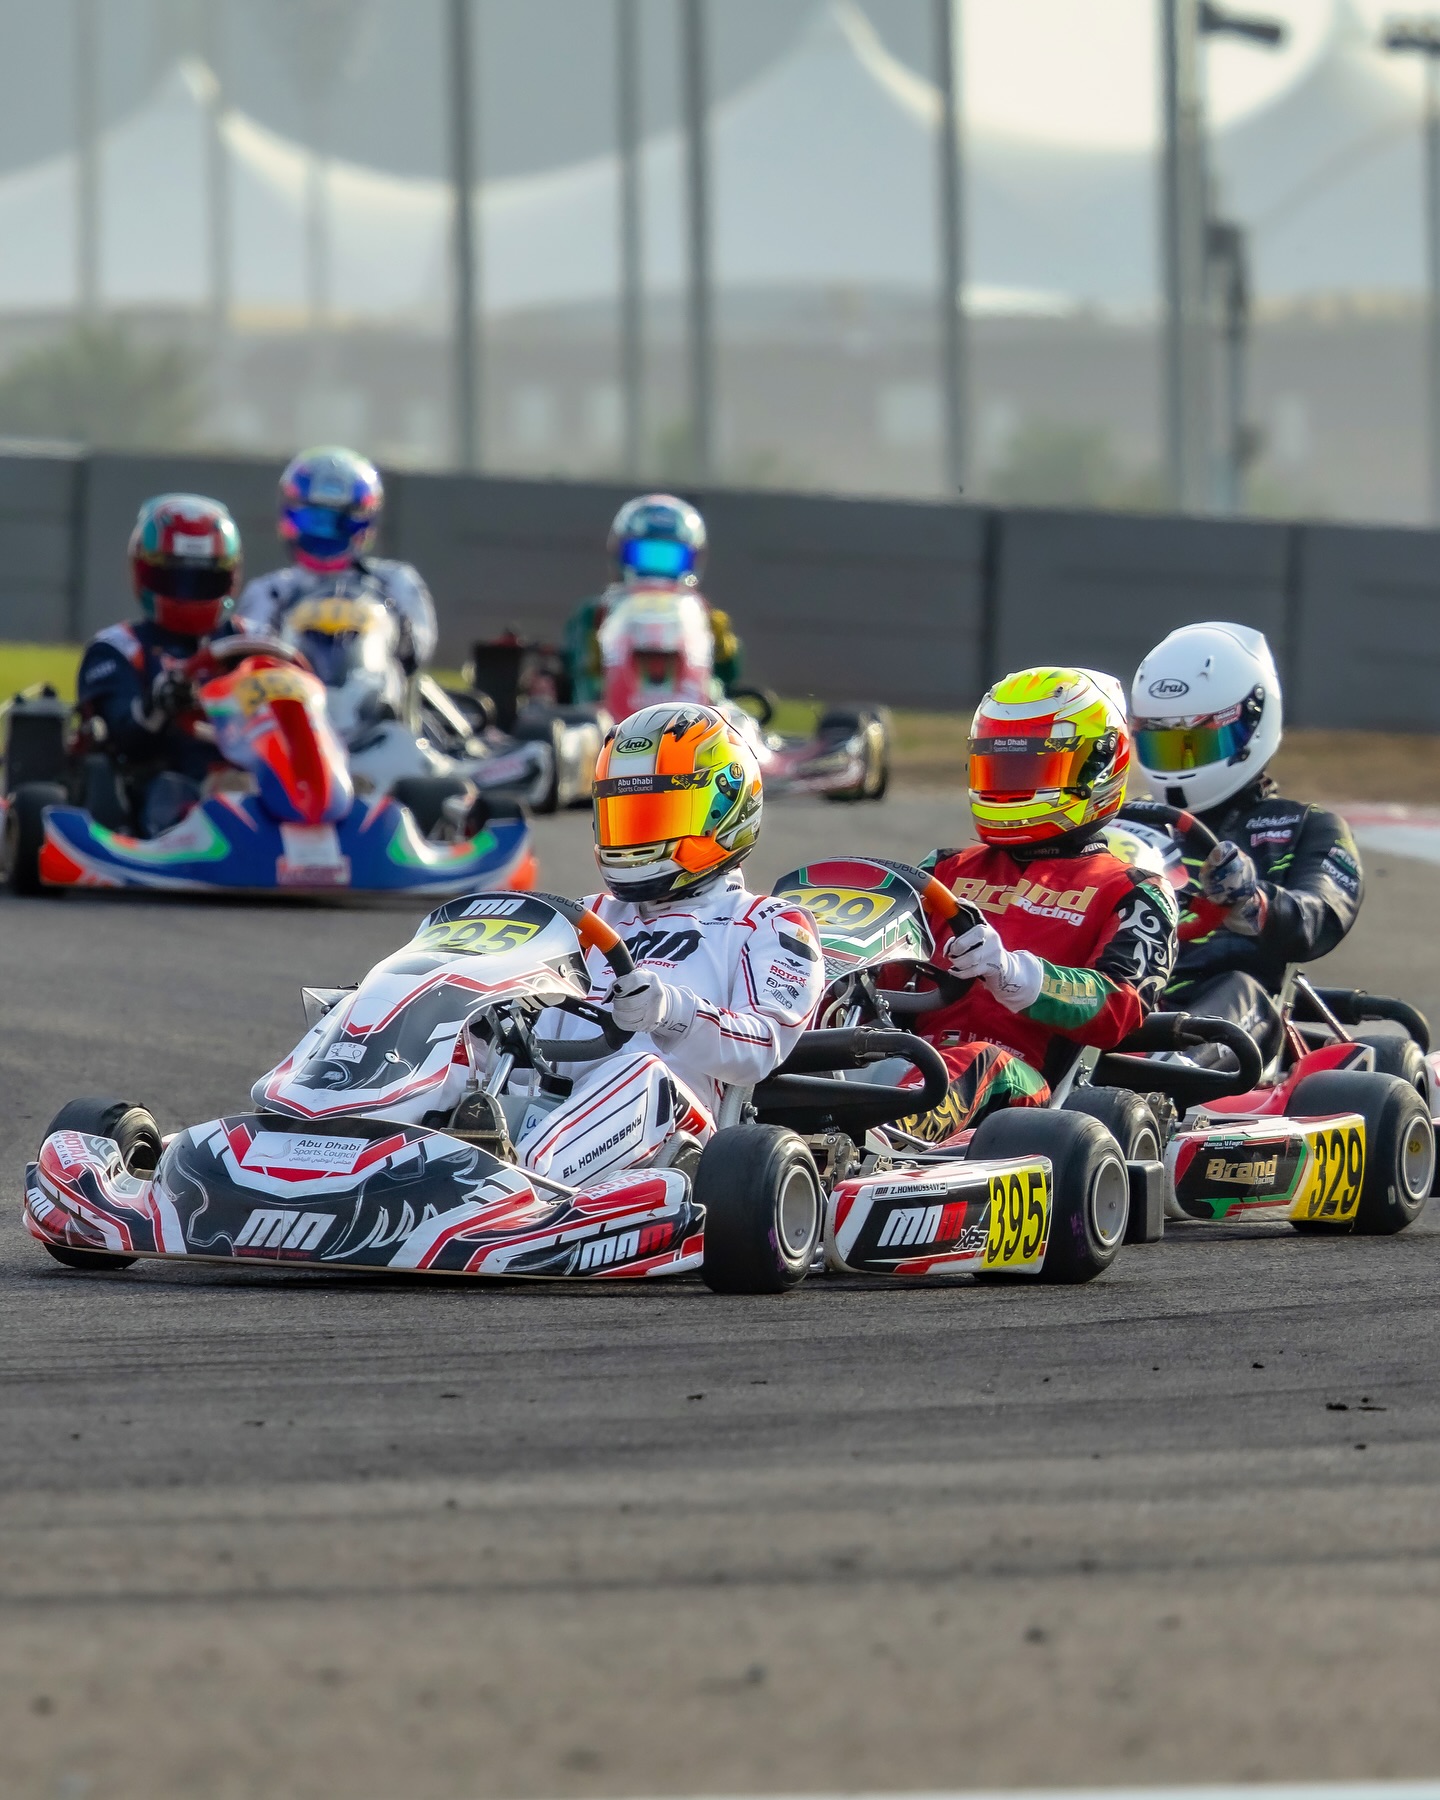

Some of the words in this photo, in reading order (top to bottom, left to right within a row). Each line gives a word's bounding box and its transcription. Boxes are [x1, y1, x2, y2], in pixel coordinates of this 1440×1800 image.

[1150, 680, 1183, 693] Arai
[619, 739, 648, 750] Arai
[1007, 738, 1028, 746] Dhabi
[632, 777, 653, 785] Dhabi
[951, 877, 1099, 913] Brand
[1015, 896, 1086, 927] Racing
[770, 965, 807, 985] ROTAX
[1041, 974, 1097, 997] Brand
[53, 1135, 72, 1166] RACING
[62, 1133, 90, 1162] ROTAX
[292, 1148, 321, 1157] Sports
[323, 1149, 357, 1159] Council
[297, 1140, 321, 1148] Abu
[324, 1141, 361, 1151] Dhabi
[562, 1165, 577, 1179] EL
[578, 1114, 642, 1169] HOMMOSSANY
[1205, 1155, 1278, 1179] Brand
[1308, 1127, 1363, 1218] 329
[987, 1172, 1044, 1264] 395
[953, 1225, 989, 1251] XPS
